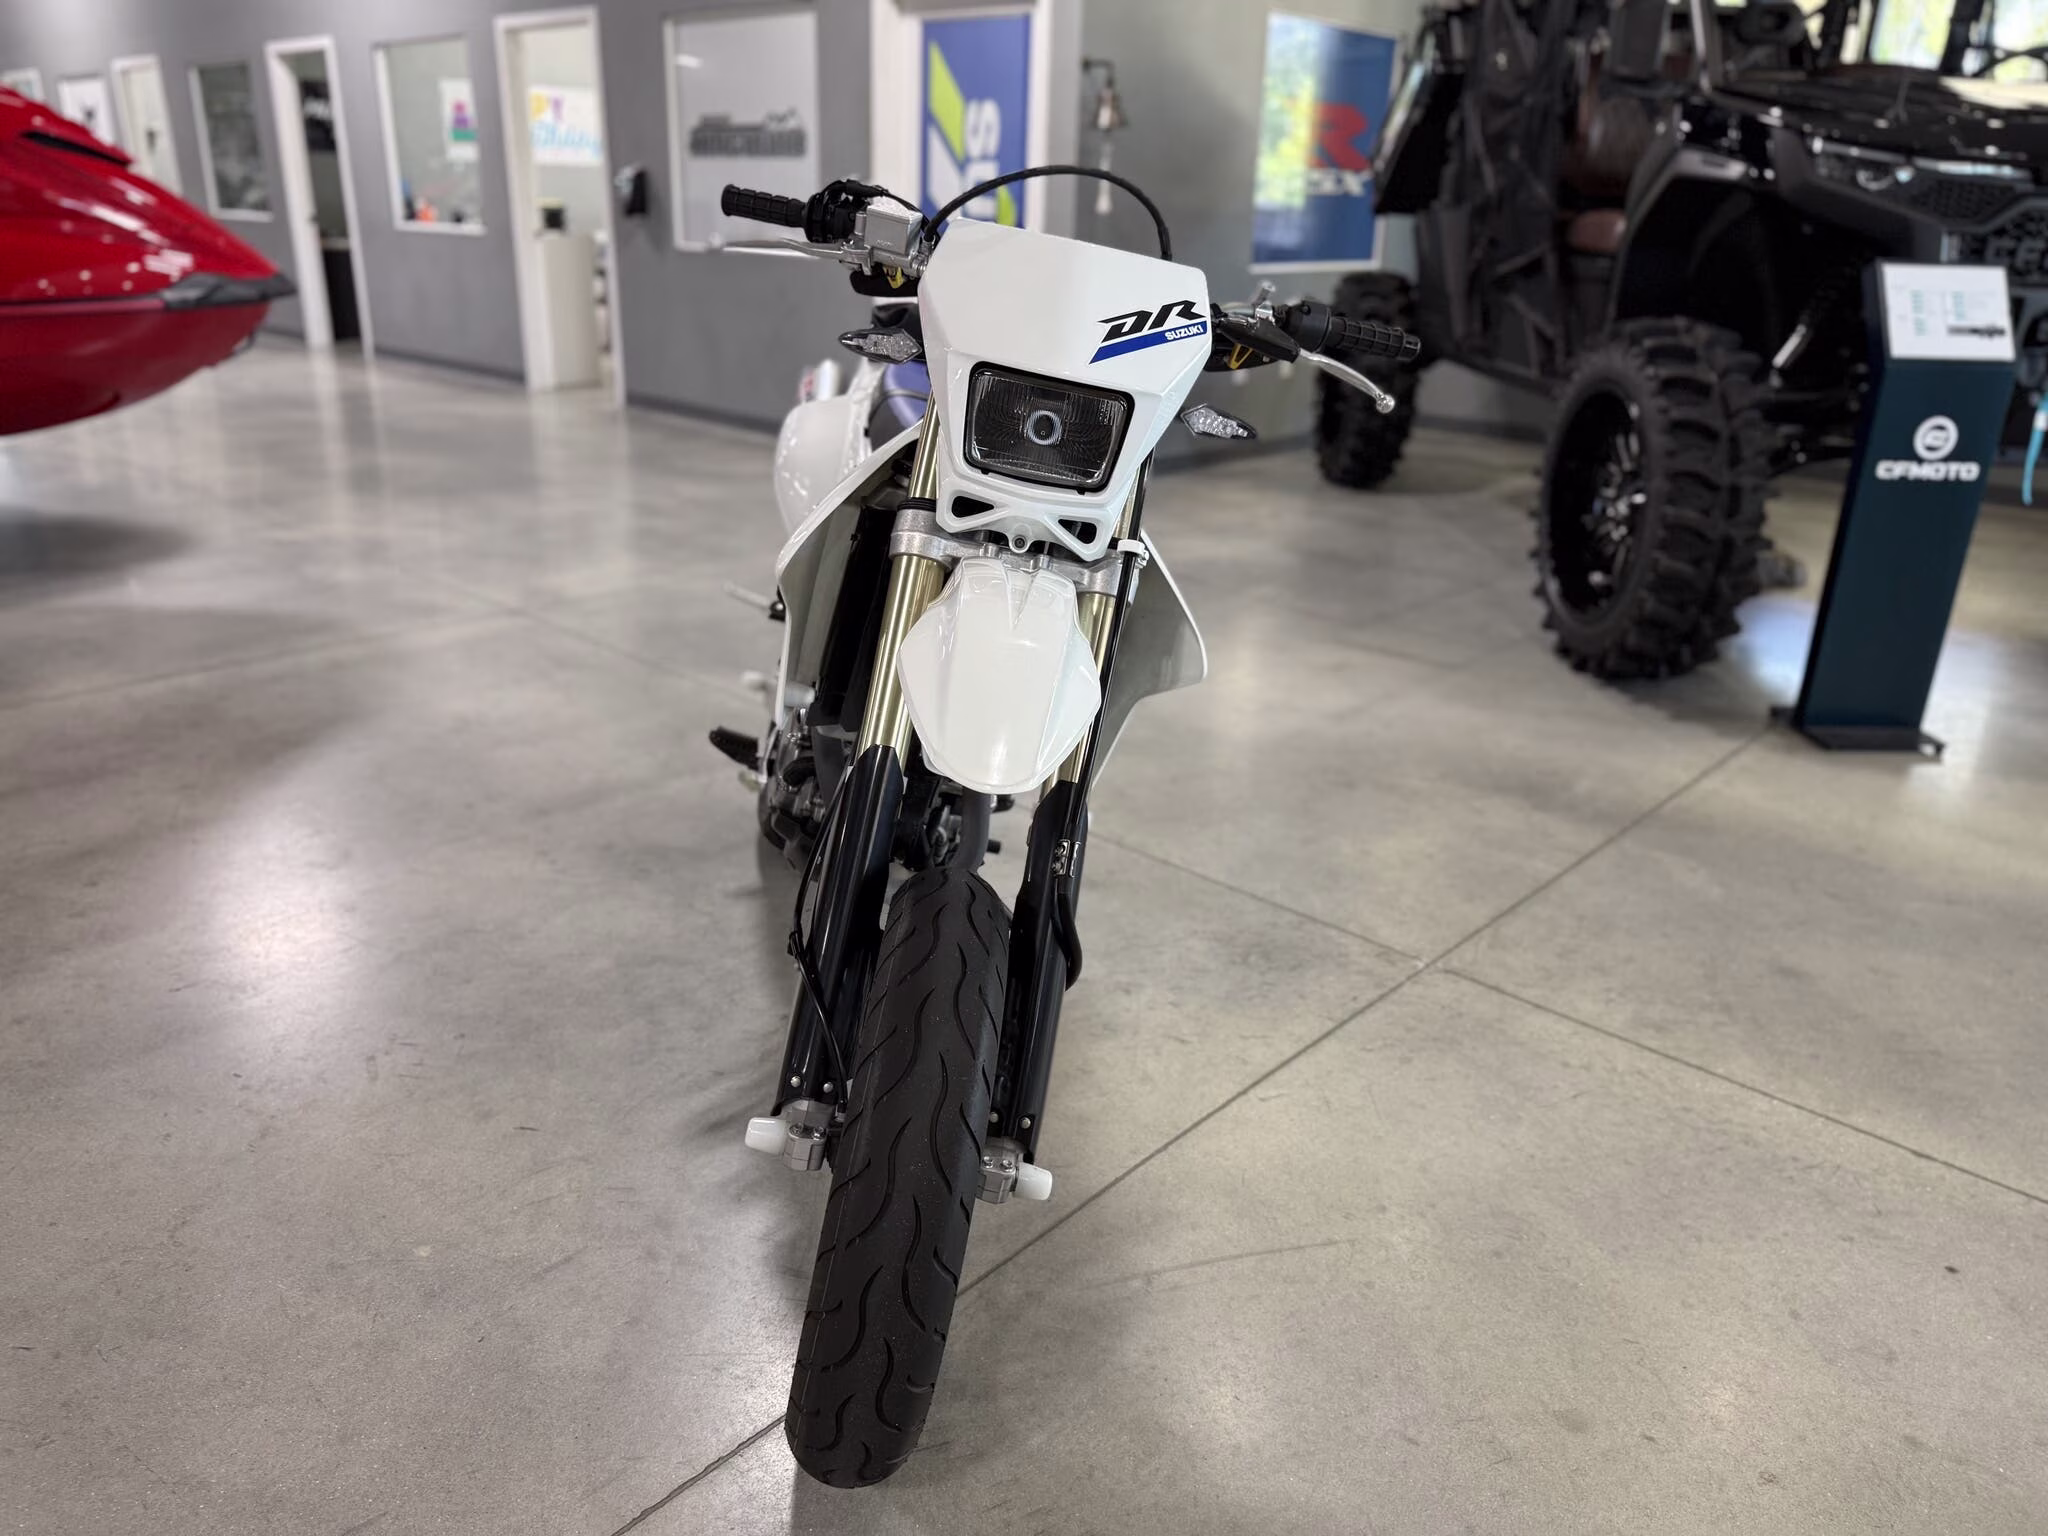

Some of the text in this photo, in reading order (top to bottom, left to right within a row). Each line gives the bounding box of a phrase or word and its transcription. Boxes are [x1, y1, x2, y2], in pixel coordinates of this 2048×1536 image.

[1097, 300, 1206, 343] DR
[1165, 325, 1204, 340] SUZUKI
[1875, 459, 1981, 481] CFMOTO
